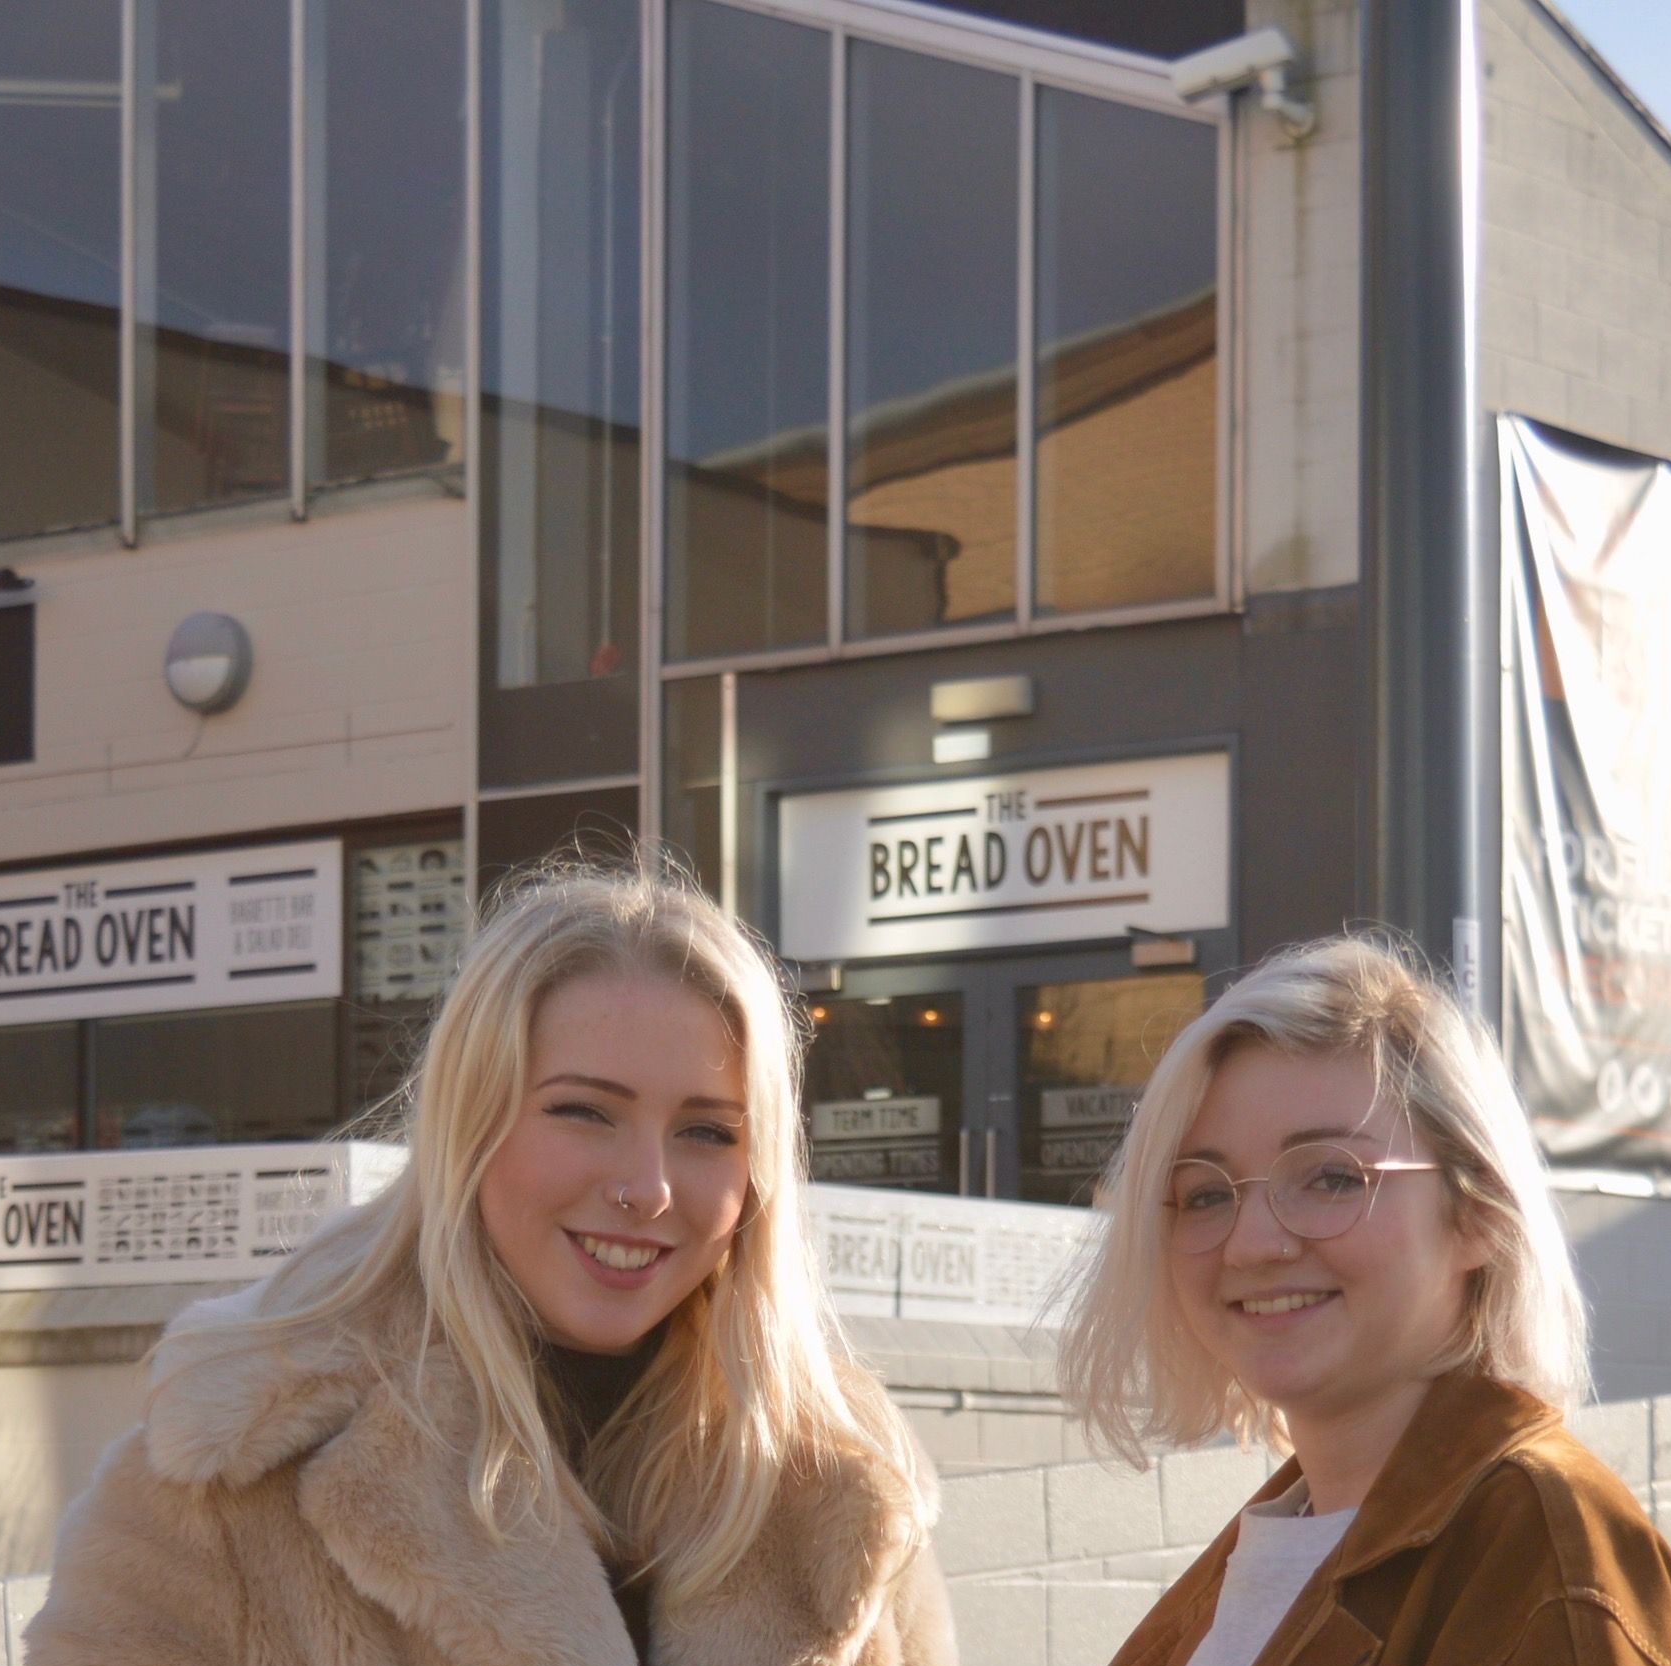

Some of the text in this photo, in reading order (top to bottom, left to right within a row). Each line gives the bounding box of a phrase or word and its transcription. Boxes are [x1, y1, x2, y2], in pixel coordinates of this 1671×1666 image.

[985, 791, 1027, 823] THE
[868, 815, 1150, 901] BREAD OVEN
[64, 881, 97, 910] THE
[95, 904, 195, 968] OVEN
[4, 1201, 84, 1247] OVEN
[912, 1238, 976, 1287] OVEN
